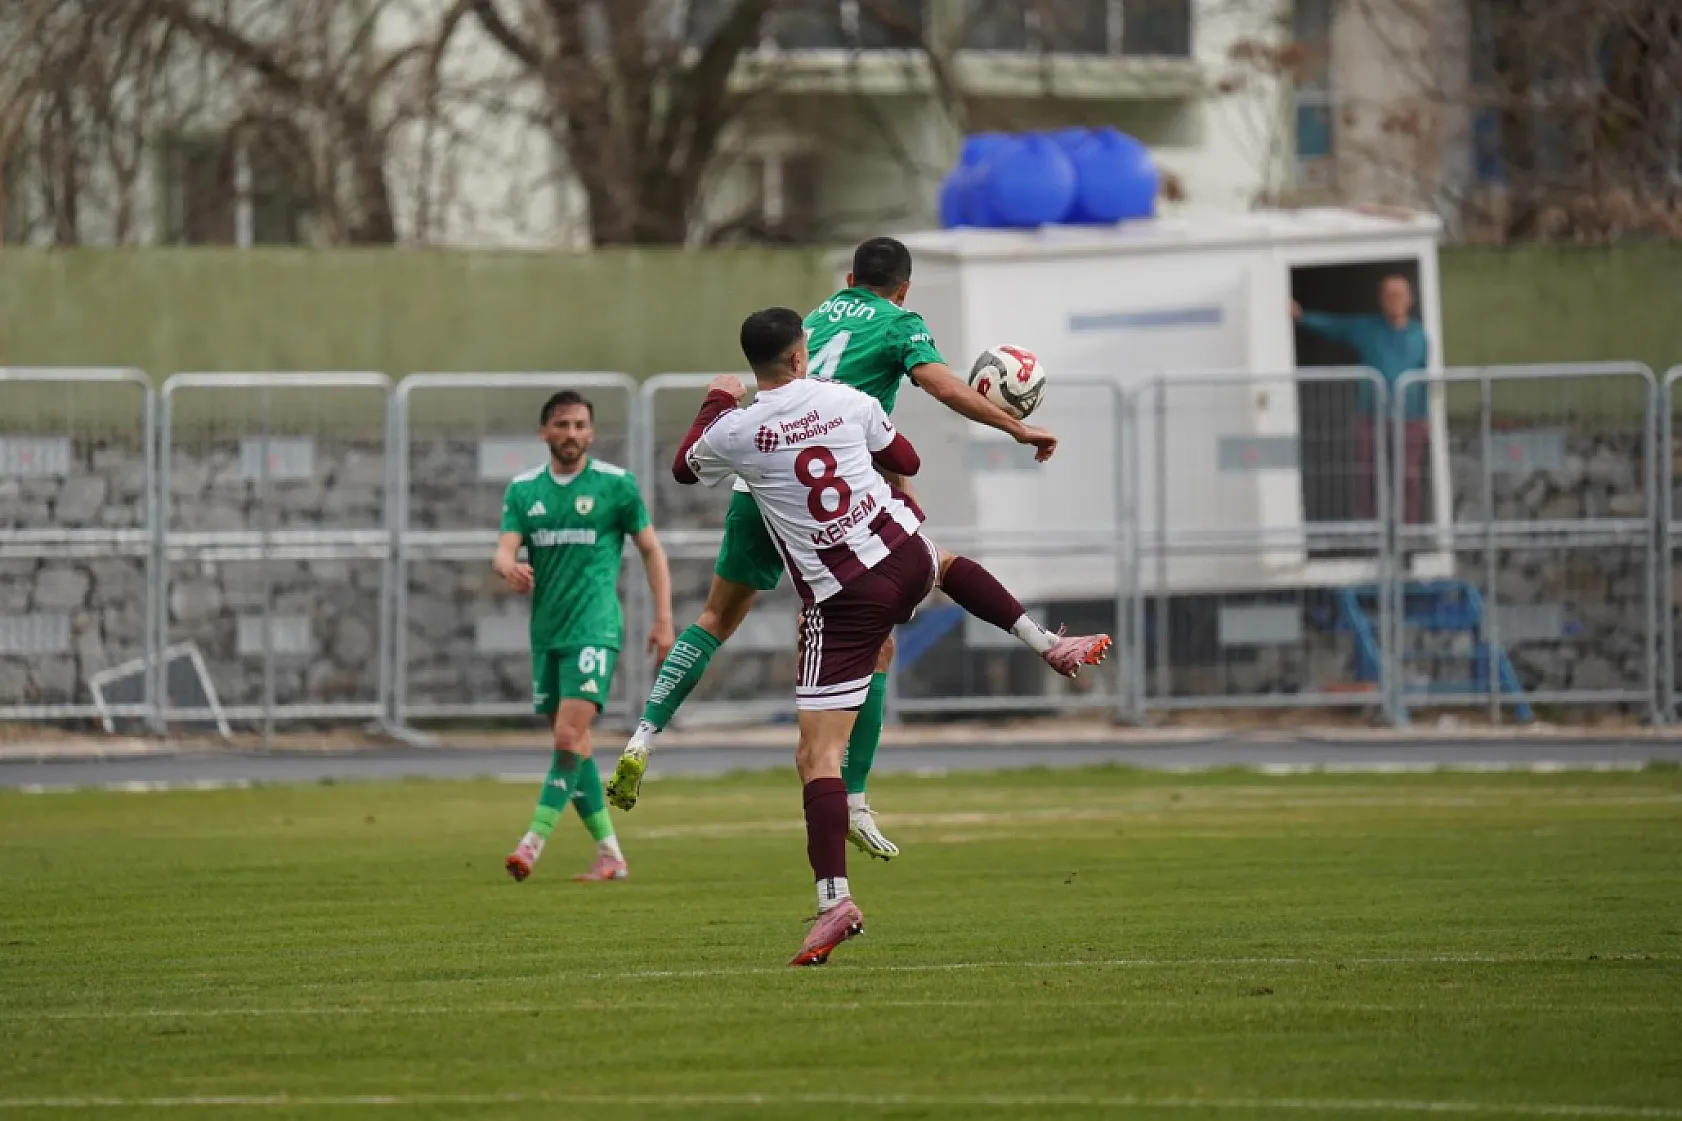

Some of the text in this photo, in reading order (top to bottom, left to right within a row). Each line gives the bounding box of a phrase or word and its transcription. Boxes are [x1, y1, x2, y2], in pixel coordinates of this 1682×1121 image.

[785, 416, 845, 446] Mobilyası
[794, 445, 852, 523] 8
[810, 493, 877, 545] KEREM
[579, 646, 608, 676] 61
